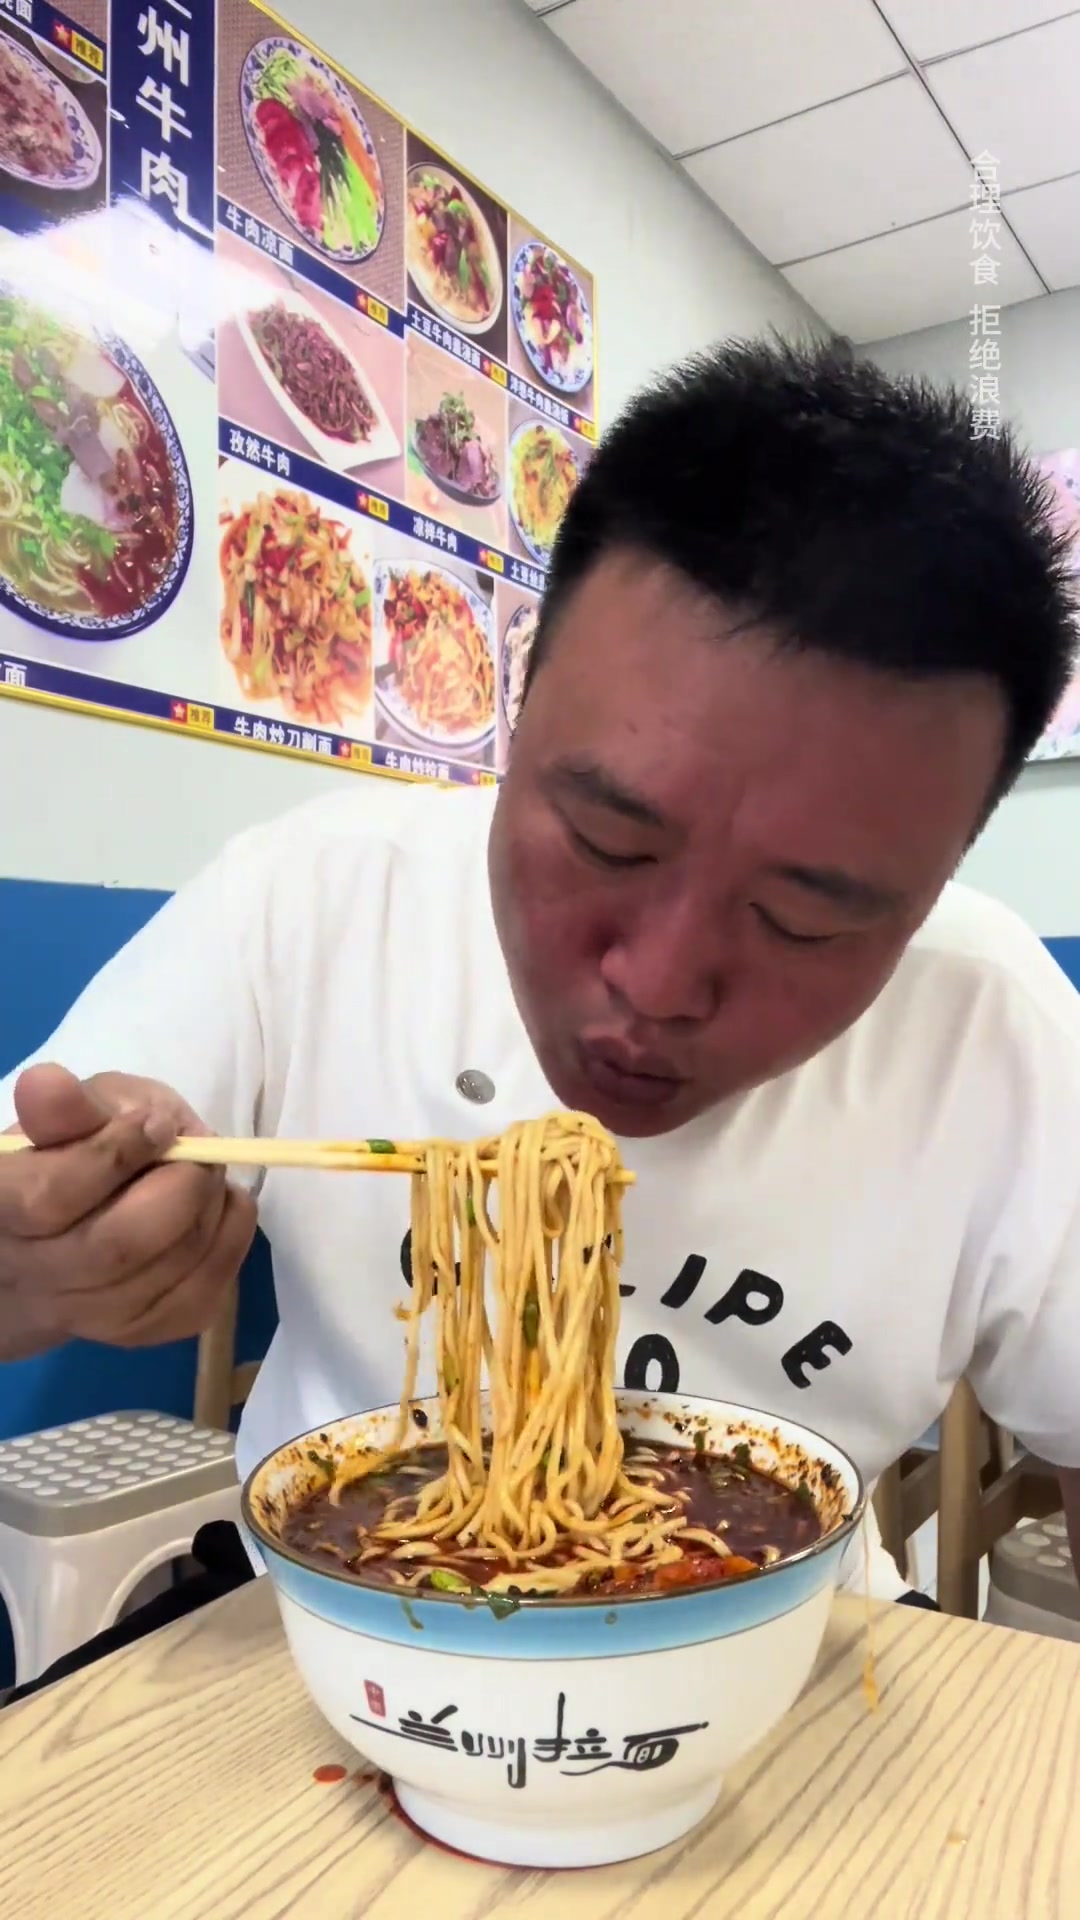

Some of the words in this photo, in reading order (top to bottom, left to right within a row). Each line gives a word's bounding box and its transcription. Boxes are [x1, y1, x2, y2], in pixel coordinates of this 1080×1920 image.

[136, 0, 193, 221] 州牛肉
[226, 205, 294, 266] 牛肉凉面
[229, 428, 291, 477] 孜然牛肉
[412, 516, 458, 552] 凉拌牛肉
[0, 661, 27, 687] 面
[189, 709, 212, 727] 推荐
[234, 716, 332, 756] 牛肉炒刀削面
[350, 1692, 709, 1788] 兰州拉面
